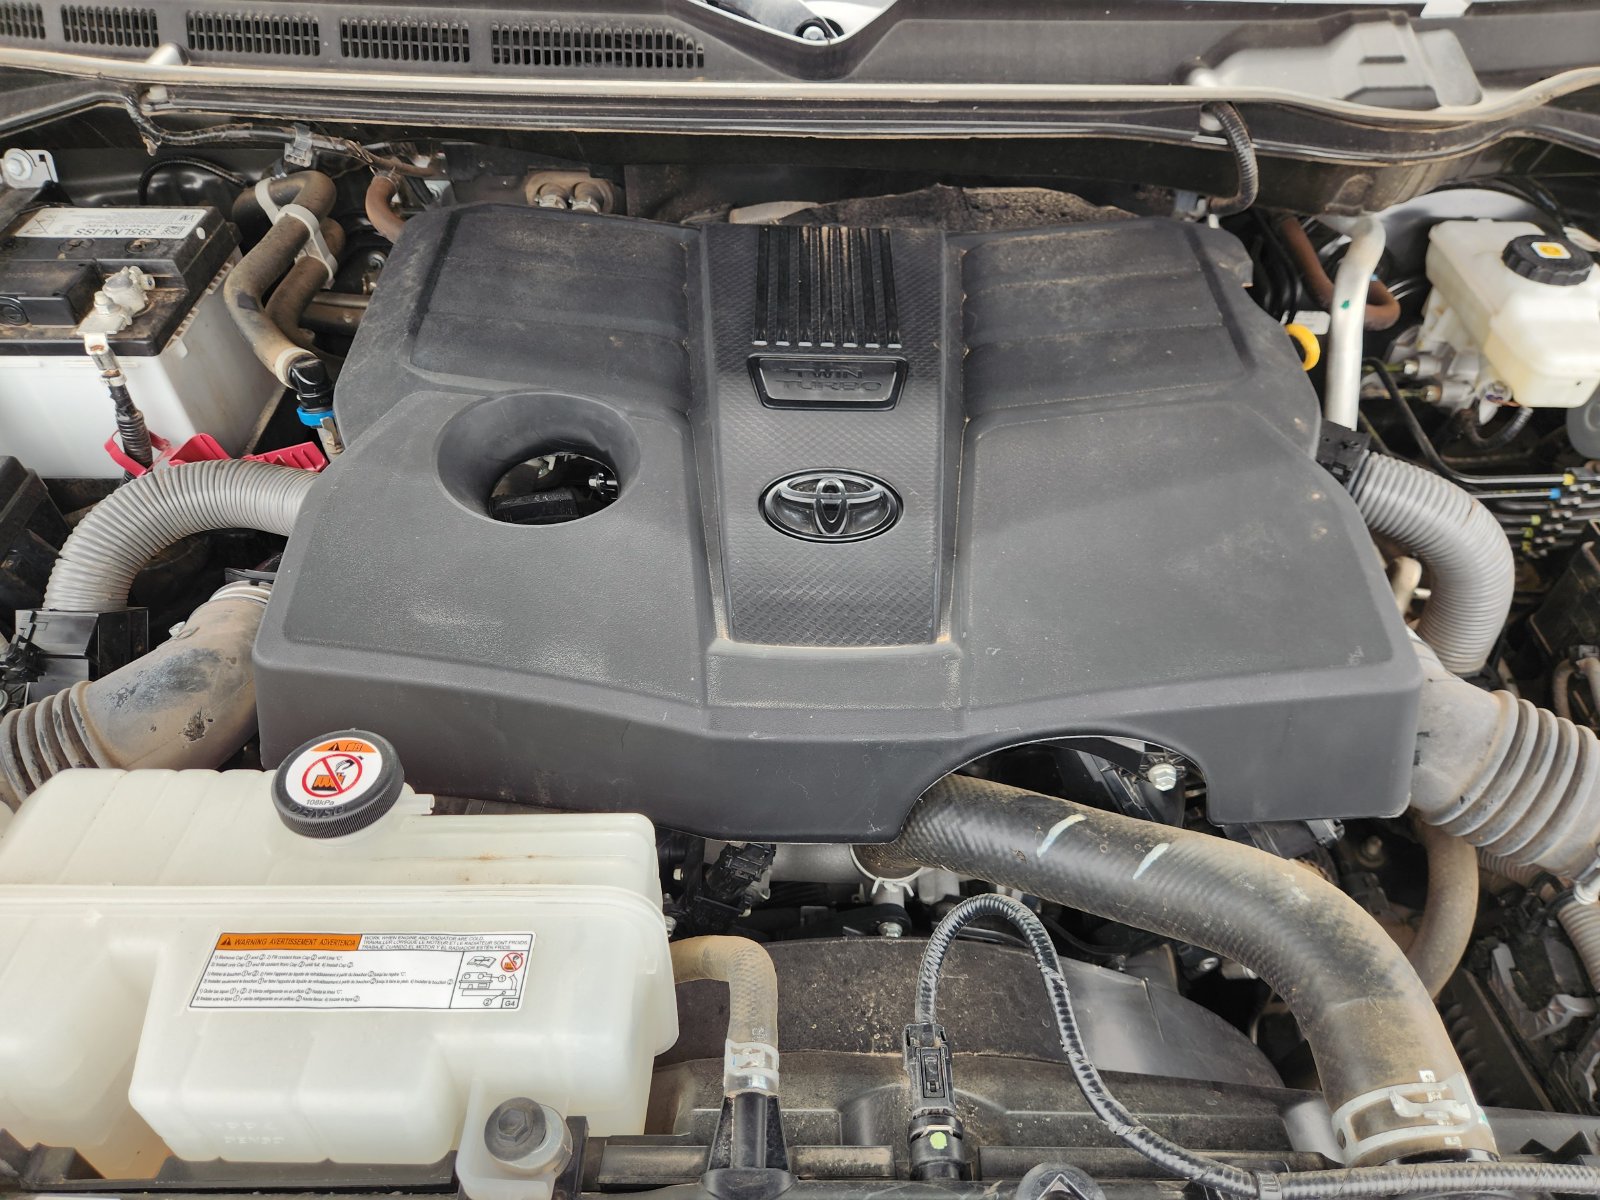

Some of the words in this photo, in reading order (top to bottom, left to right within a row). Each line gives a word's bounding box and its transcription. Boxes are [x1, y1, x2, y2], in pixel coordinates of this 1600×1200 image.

[788, 368, 863, 379] TWIN
[774, 380, 882, 392] TURBO
[290, 805, 346, 818] DENSO
[235, 938, 267, 946] WARNING
[270, 938, 317, 946] AVERTISSEMENT
